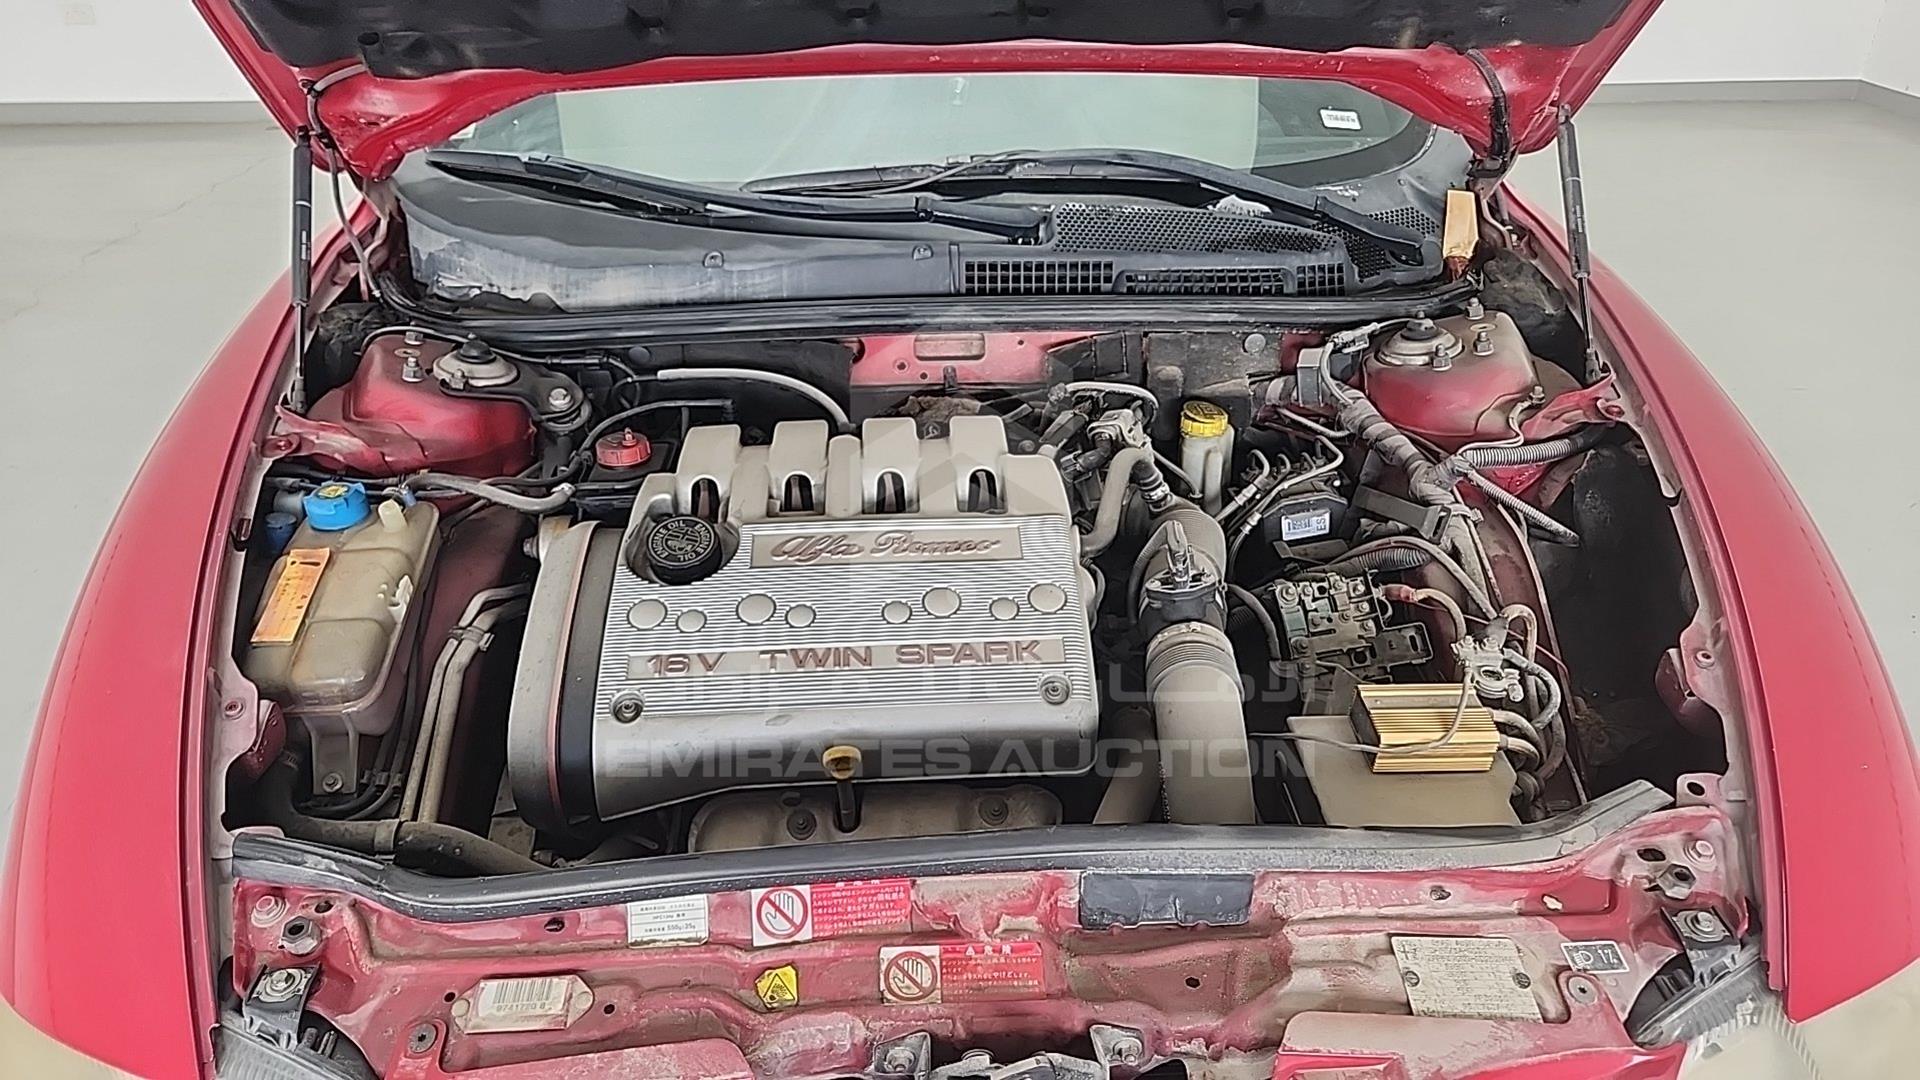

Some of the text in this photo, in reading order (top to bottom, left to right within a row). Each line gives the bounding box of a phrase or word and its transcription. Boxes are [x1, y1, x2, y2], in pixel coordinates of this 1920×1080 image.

[653, 520, 685, 558] ENGINE OIL
[677, 523, 711, 561] ENGINE OIL
[771, 529, 1001, 564] Alfa Romeo
[758, 645, 873, 674] TWIN
[894, 639, 1043, 667] SPARK
